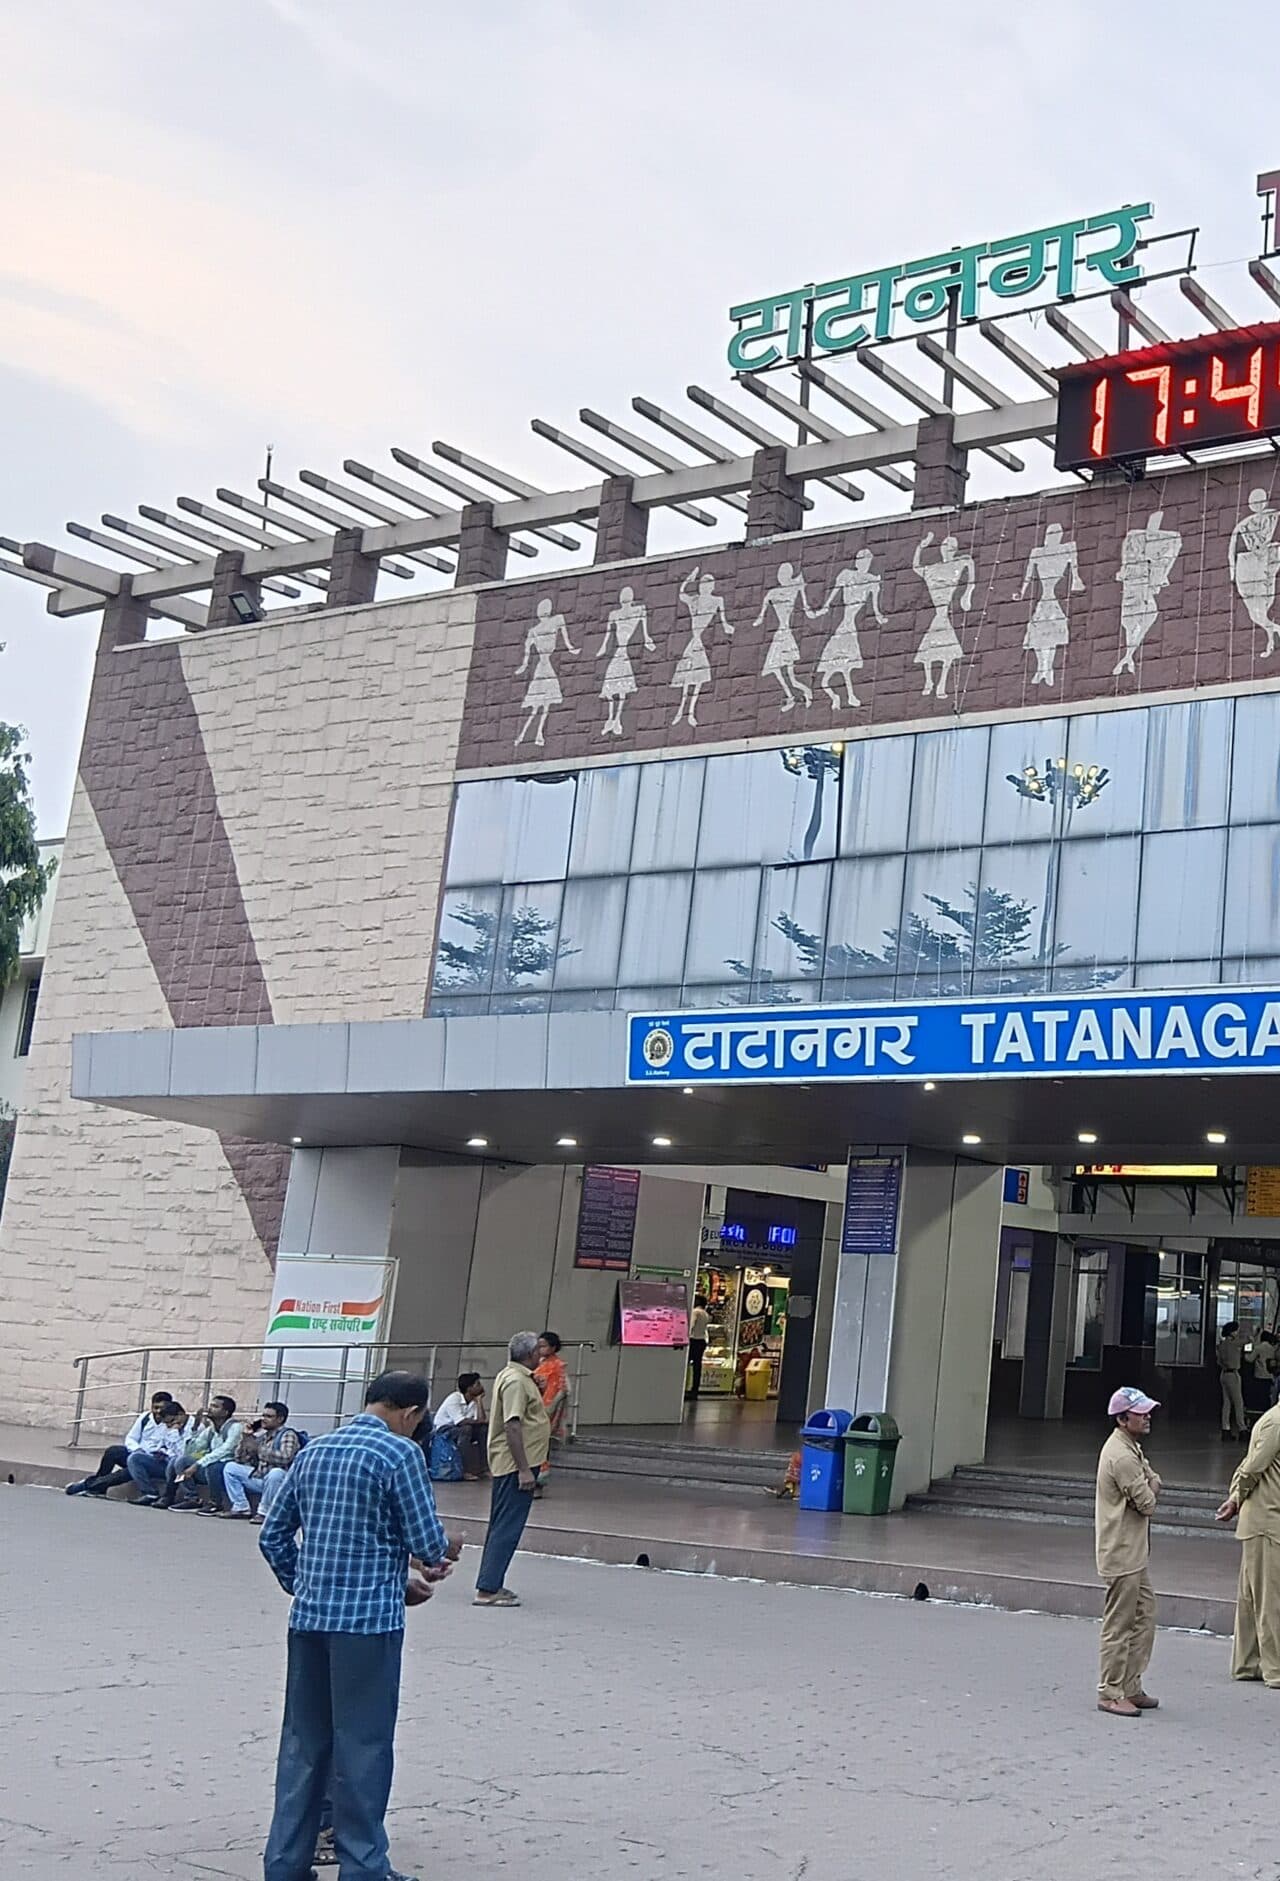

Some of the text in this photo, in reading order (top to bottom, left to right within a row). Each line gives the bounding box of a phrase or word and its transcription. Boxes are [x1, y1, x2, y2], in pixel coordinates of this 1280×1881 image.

[727, 202, 1155, 370] टाटानगर
[681, 1015, 919, 1072] टाटानगर
[296, 1300, 341, 1314] Nation First
